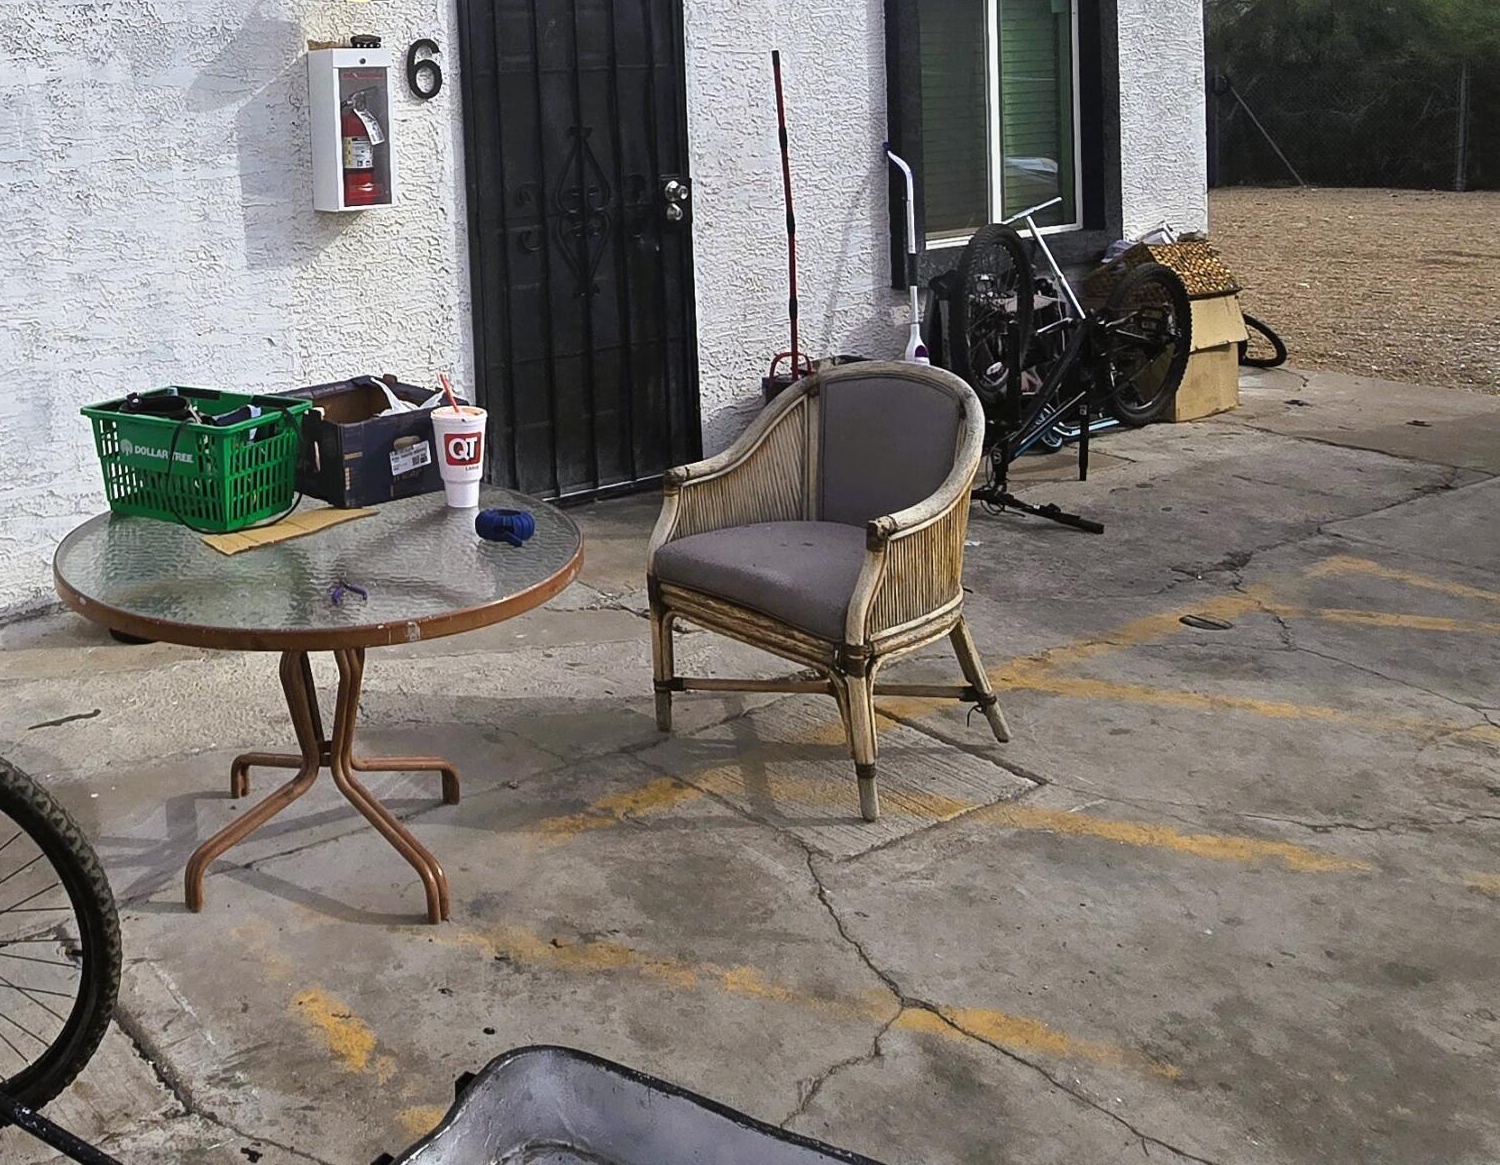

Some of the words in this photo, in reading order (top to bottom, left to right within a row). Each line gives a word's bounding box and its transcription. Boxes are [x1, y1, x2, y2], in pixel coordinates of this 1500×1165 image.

[406, 38, 443, 100] 6
[134, 445, 169, 460] DOLLAR
[172, 451, 194, 464] TREE
[448, 436, 478, 461] QT
